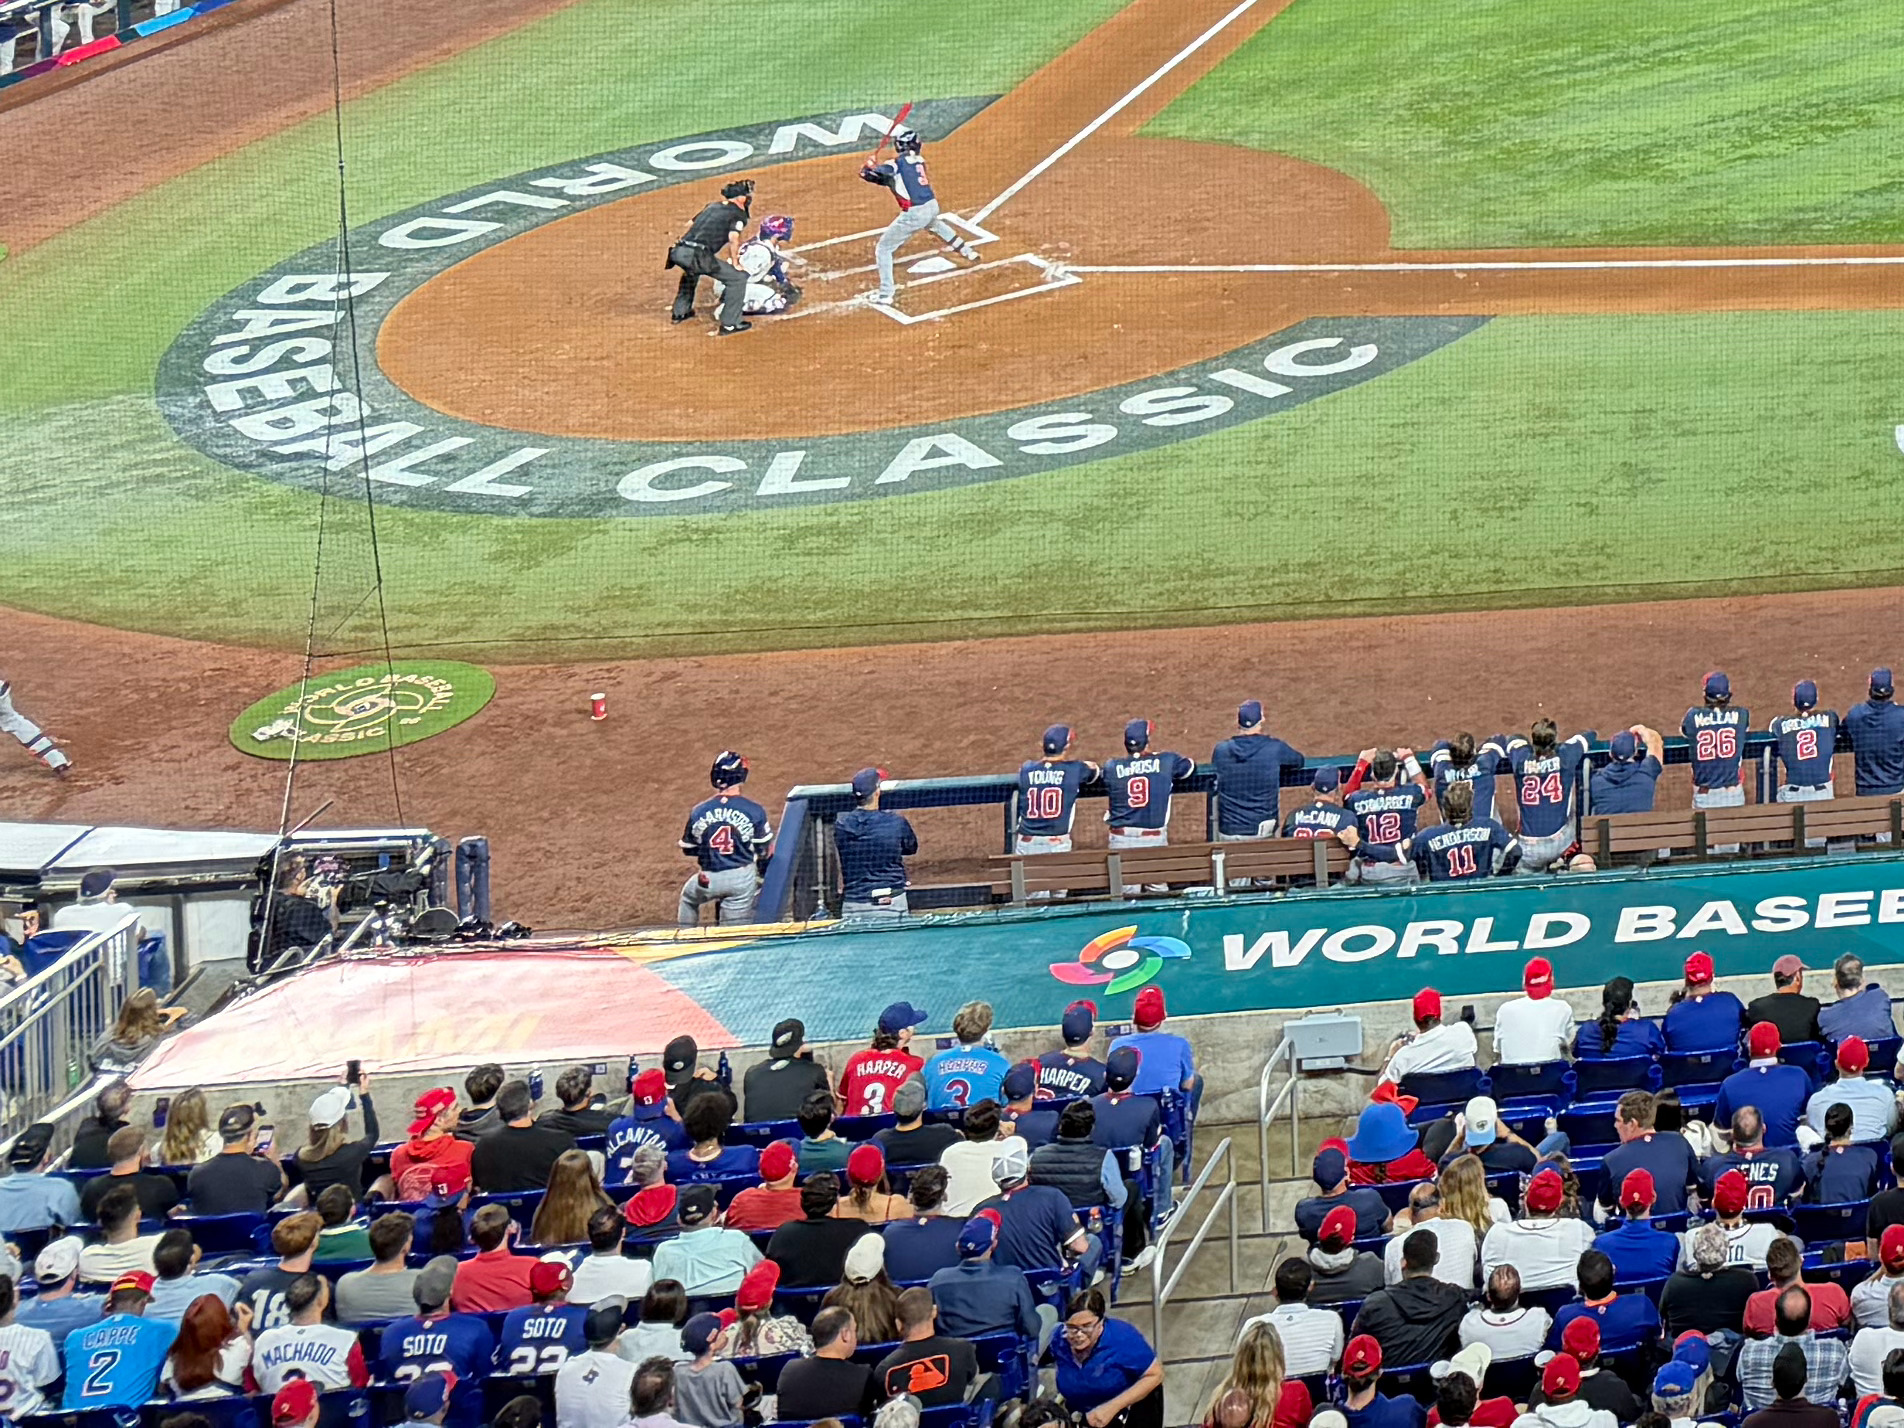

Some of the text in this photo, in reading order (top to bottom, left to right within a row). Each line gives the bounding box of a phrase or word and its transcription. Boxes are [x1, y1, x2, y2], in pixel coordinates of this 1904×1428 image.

[378, 112, 910, 252] WORLD
[202, 271, 551, 501] BASEBALL
[615, 334, 1381, 508] CLASSIC
[1696, 728, 1736, 761] 26
[1796, 730, 1818, 760] 2
[1028, 770, 1065, 785] YOUNG
[1116, 759, 1160, 779] DeROSA
[1026, 787, 1062, 819] 10
[1128, 776, 1149, 808] 9
[1521, 773, 1562, 805] 24
[710, 826, 734, 854] 4
[1366, 812, 1402, 844] 12
[1429, 828, 1490, 852] HENDERSON
[1447, 844, 1476, 877] 11
[1221, 909, 1592, 972] WORLD
[857, 1060, 906, 1079] HARPER
[1040, 1067, 1092, 1093] HARPER
[945, 1077, 970, 1108] 3
[523, 1317, 567, 1339] SOTO
[261, 1344, 336, 1370] MACHADO
[403, 1334, 448, 1356] SOTO
[81, 1349, 119, 1396] 2
